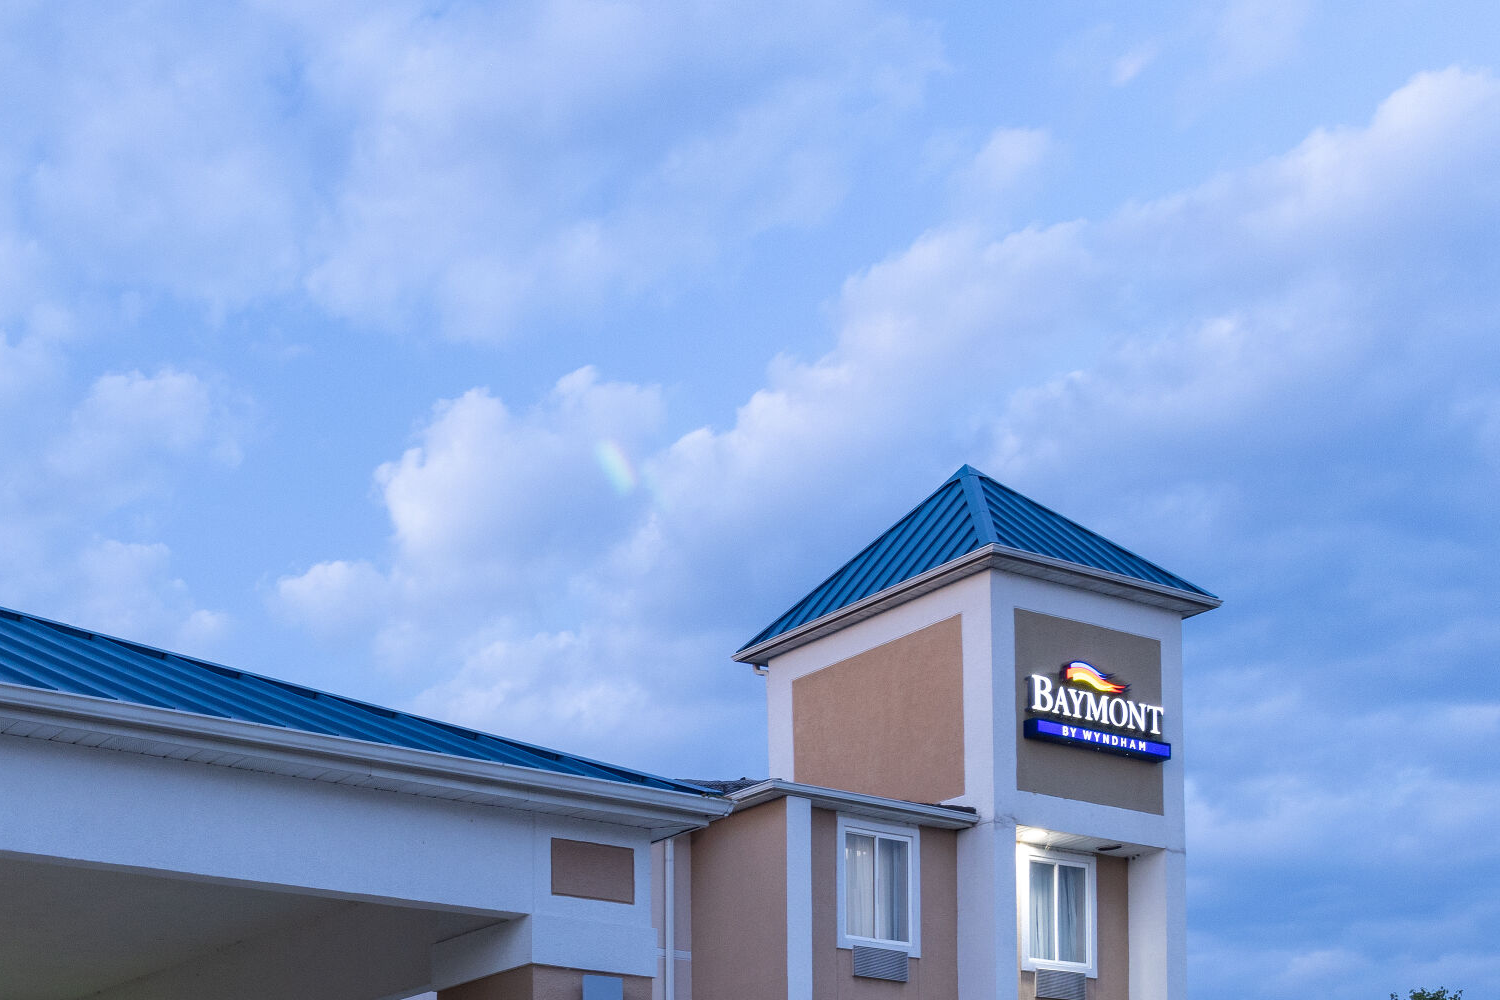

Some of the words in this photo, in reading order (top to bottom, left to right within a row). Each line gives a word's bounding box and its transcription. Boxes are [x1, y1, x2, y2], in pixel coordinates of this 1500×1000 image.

[1032, 674, 1164, 734] BAYMONT
[1062, 726, 1077, 738] BY
[1083, 730, 1146, 751] WYNDHAM
